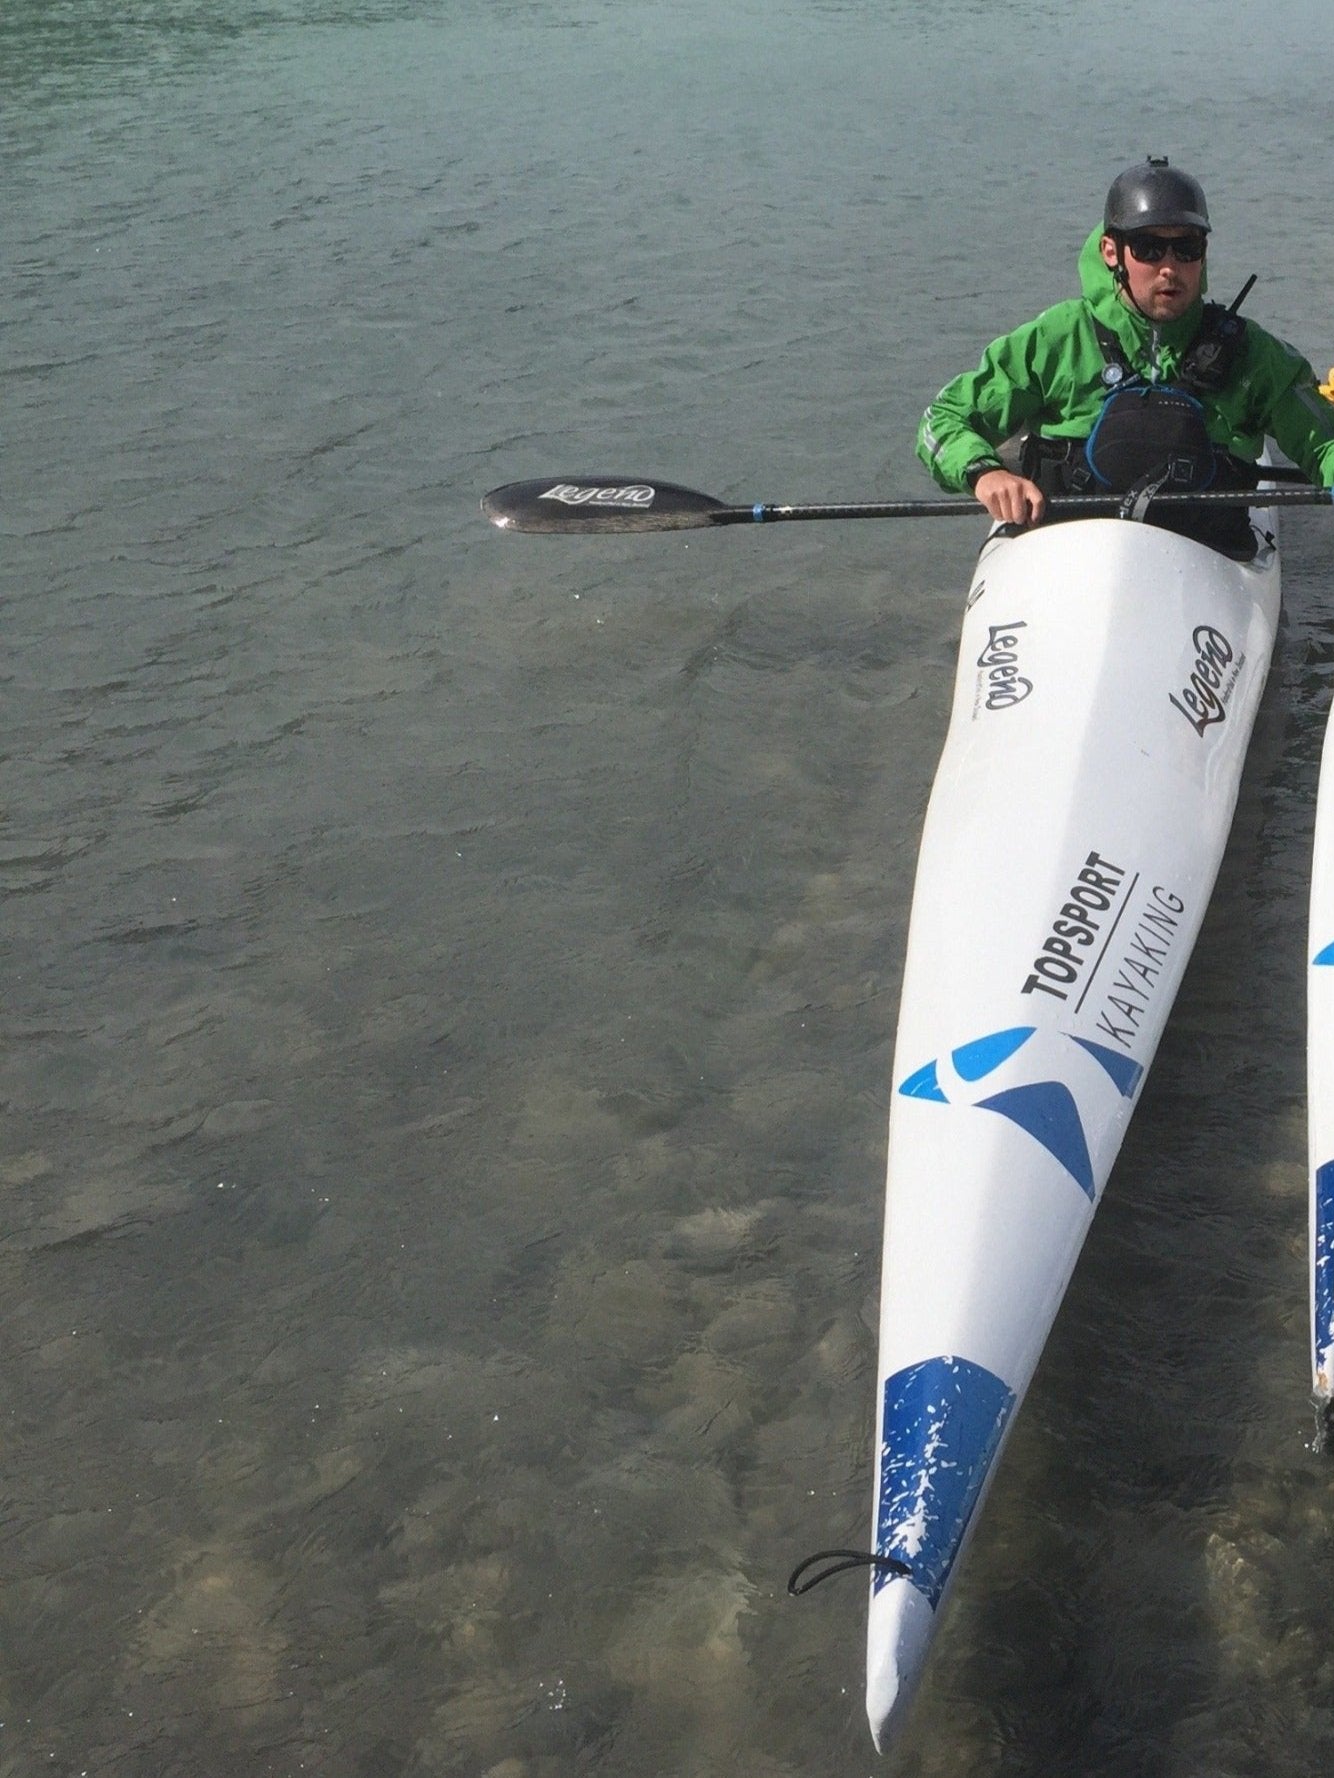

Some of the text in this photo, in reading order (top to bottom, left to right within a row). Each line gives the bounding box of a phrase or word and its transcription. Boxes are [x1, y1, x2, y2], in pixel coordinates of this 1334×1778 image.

[538, 484, 655, 505] Legend
[977, 620, 1033, 710] Legend
[1168, 625, 1233, 738] Legend
[1020, 851, 1126, 1001] TOPSPORT
[1096, 886, 1185, 1048] KAYAKING
